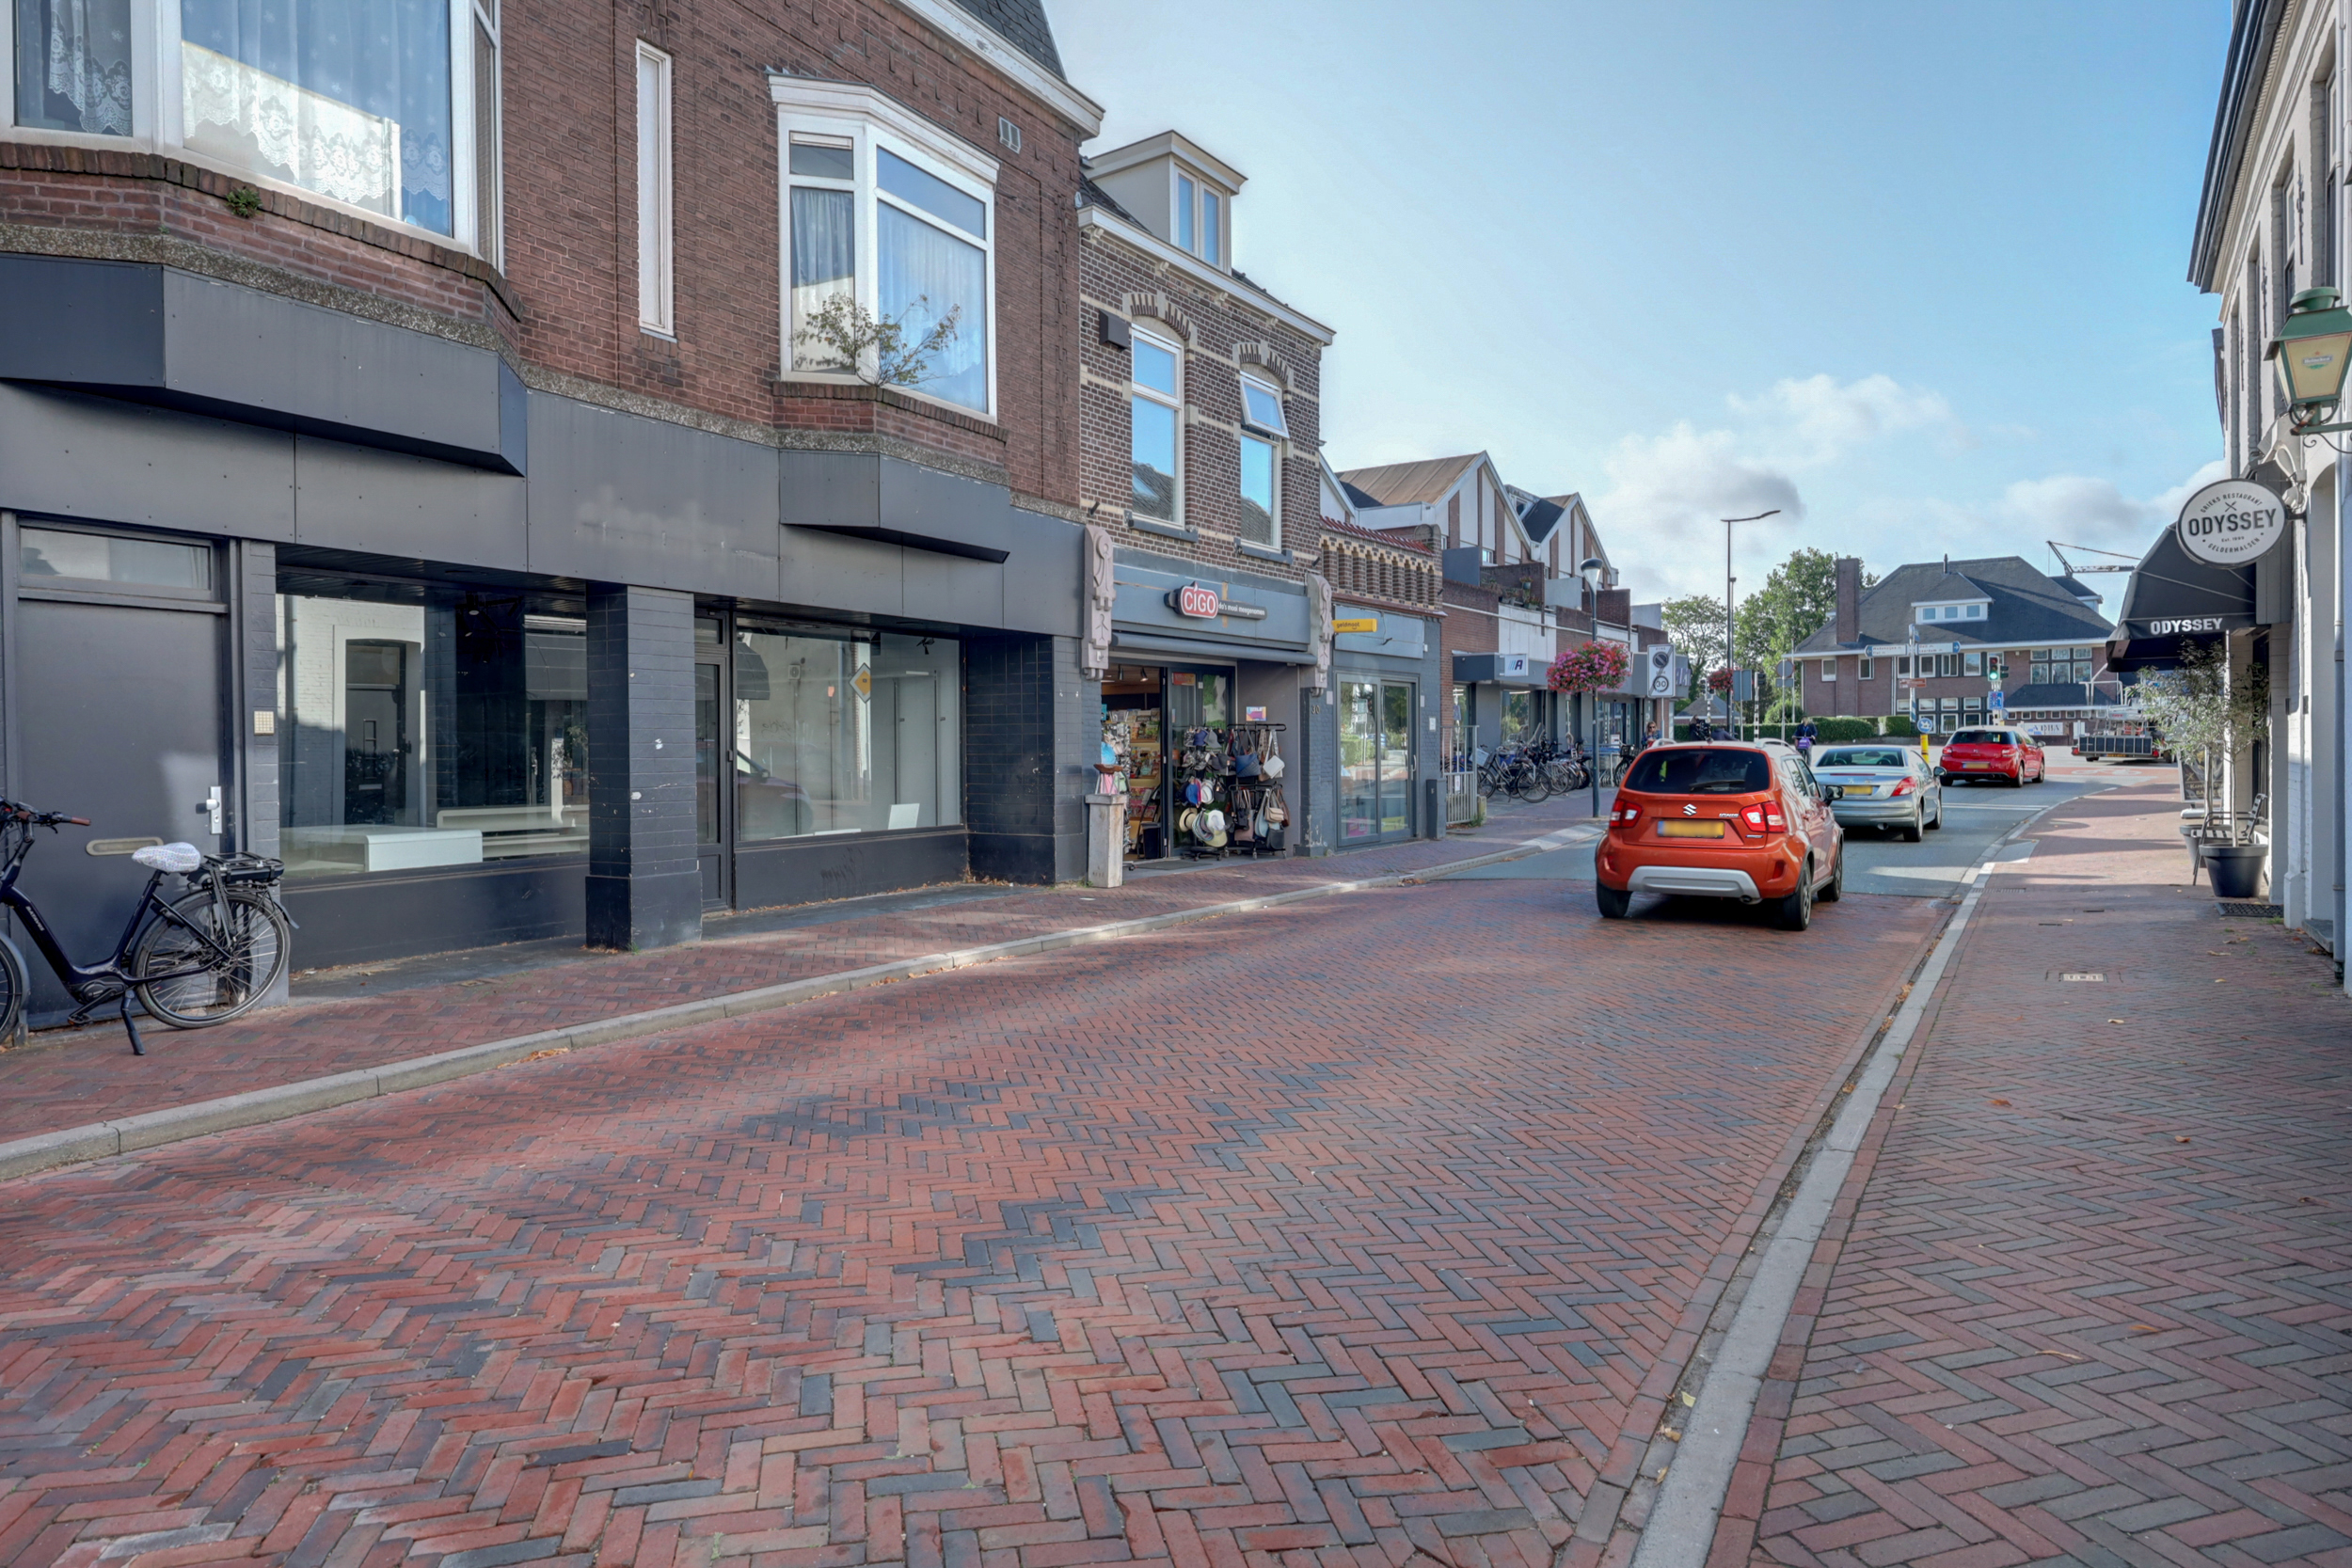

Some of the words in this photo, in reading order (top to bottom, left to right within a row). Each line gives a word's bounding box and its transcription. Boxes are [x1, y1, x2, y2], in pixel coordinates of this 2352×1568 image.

[2201, 497, 2221, 514] GRIEKS
[2222, 492, 2264, 506] RESTAURANT
[2188, 508, 2277, 536] ODYSSEY
[2207, 537, 2261, 553] GELDERMALSEN
[1184, 590, 1216, 614] CIGO
[1238, 606, 1265, 616] meegenomen
[2150, 617, 2223, 635] ODYSSEY
[1311, 705, 1321, 715] 30
[25, 906, 45, 931] BATAVUS
